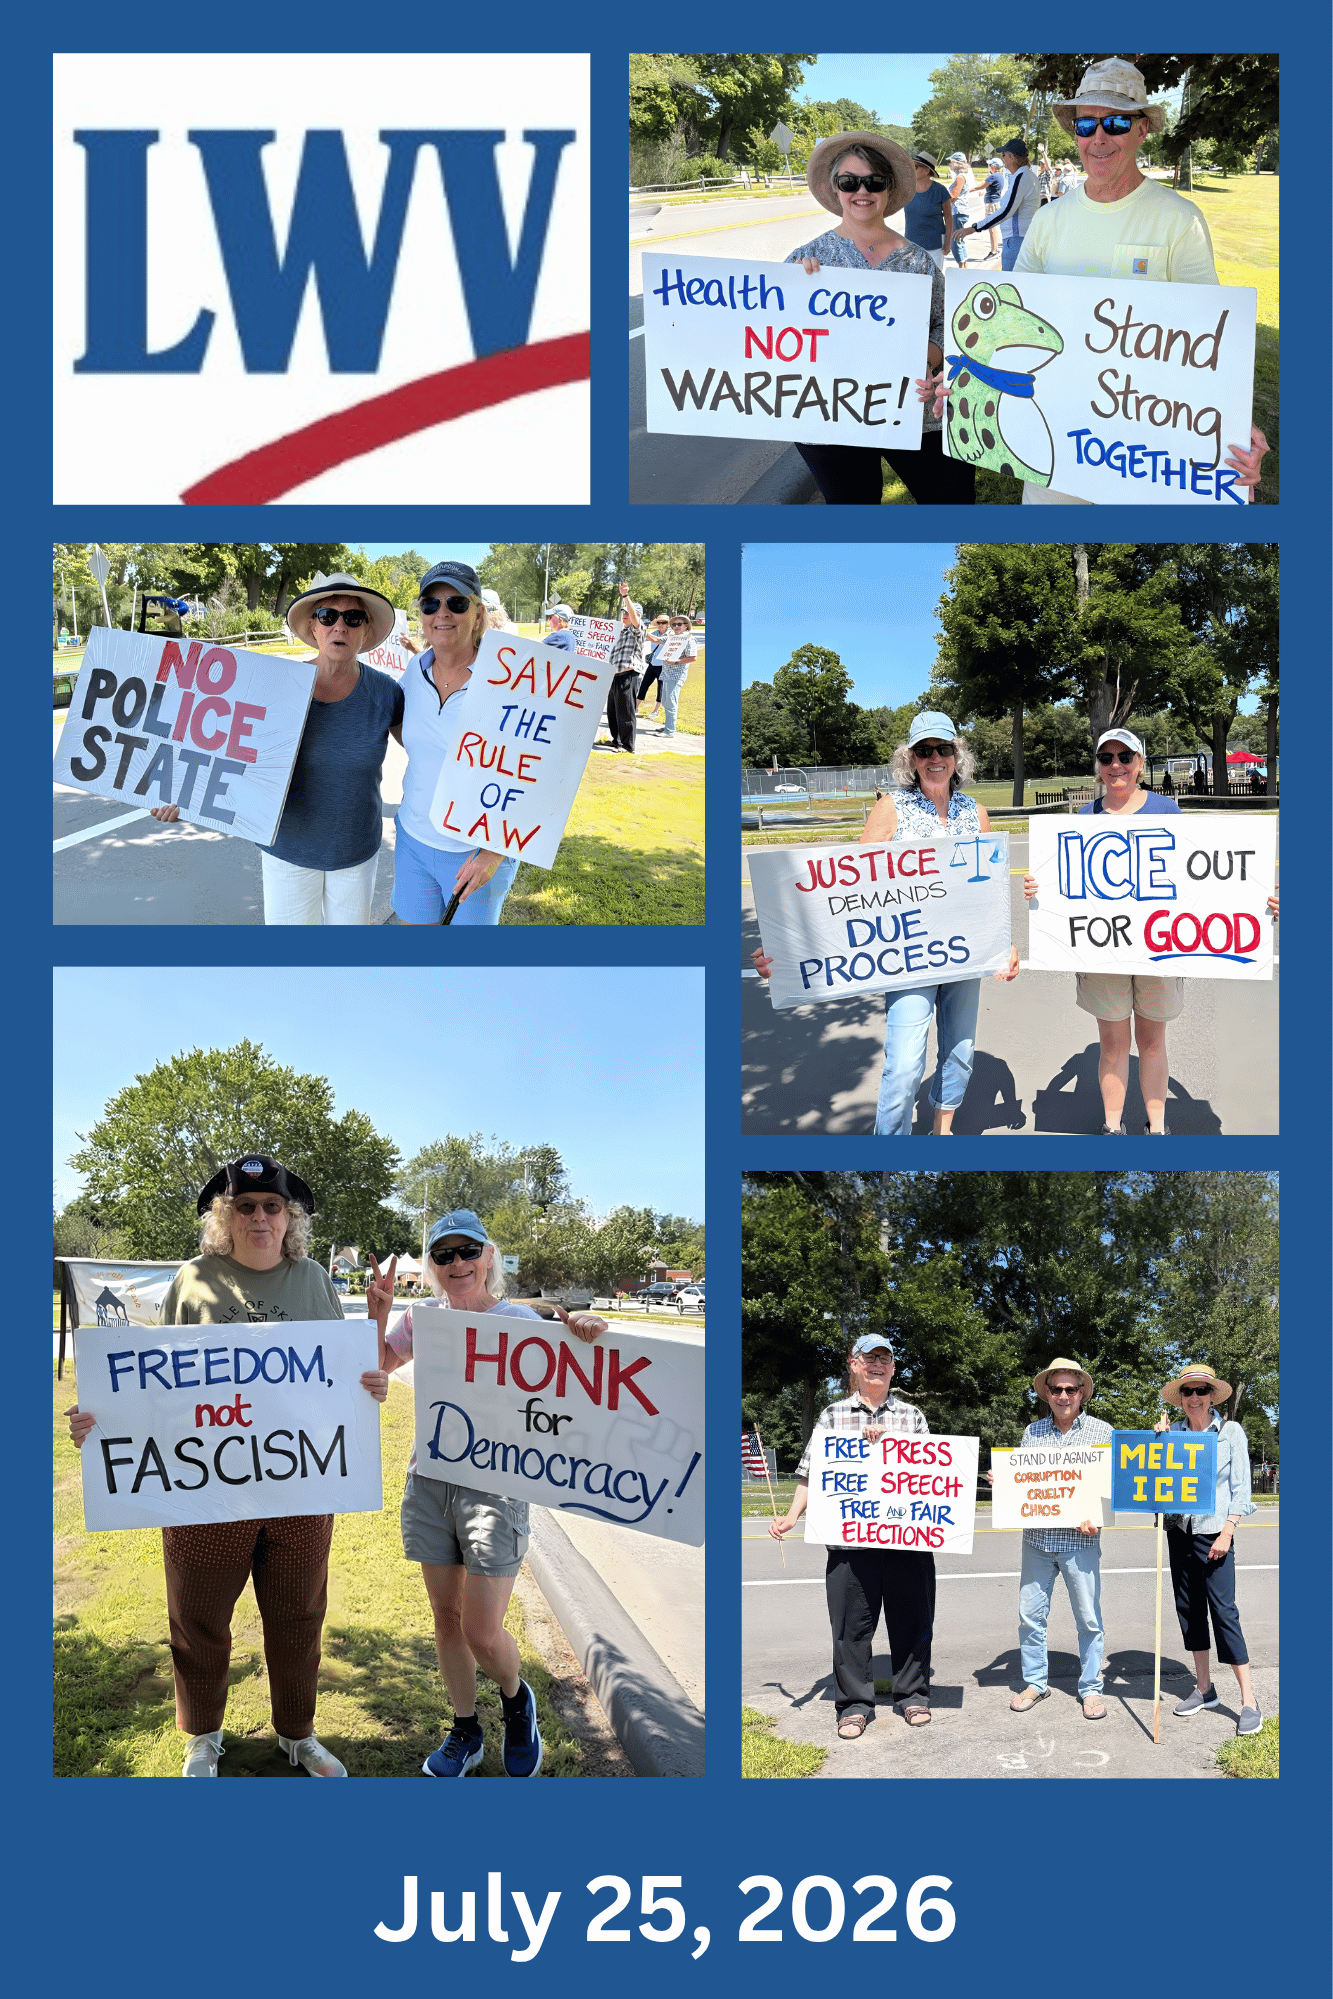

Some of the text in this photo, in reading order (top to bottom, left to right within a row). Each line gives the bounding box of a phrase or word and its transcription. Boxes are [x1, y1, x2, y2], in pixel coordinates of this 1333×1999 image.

[653, 269, 896, 327] Health care,
[744, 325, 829, 363] NOT
[1085, 297, 1229, 371] Stand
[660, 367, 909, 427] WARFARE!
[1091, 368, 1222, 471] Strong
[1067, 429, 1245, 504] TOGETHER
[587, 631, 616, 643] SPEECH
[590, 619, 614, 632] PRESS
[368, 647, 406, 672] FOR ALL
[596, 642, 610, 653] FAIR
[156, 640, 238, 695] NO
[487, 647, 598, 709] SAVE
[81, 668, 267, 763] POLICE
[499, 705, 556, 744] THE
[70, 726, 247, 825] STATE
[457, 731, 542, 783] RULE
[480, 782, 524, 812] OF
[443, 801, 541, 852] LAW
[795, 848, 940, 892] JUSTICE
[1058, 828, 1256, 901] ICE OUT
[828, 881, 947, 916] DEMANDS
[847, 909, 928, 948] DUE
[1069, 910, 1261, 954] FOR GOOD
[800, 935, 970, 990] PROCESS
[245, 1301, 264, 1309] OF
[270, 1305, 292, 1322] SK
[107, 1345, 334, 1393] FREEDOM,
[465, 1327, 660, 1416] HONK
[195, 1393, 253, 1428] not
[517, 1398, 573, 1435] for
[100, 1425, 348, 1494] FASCISM
[427, 1400, 702, 1524] Democracy!
[824, 1436, 952, 1466] FREE PRESS
[1009, 1451, 1104, 1466] STAND UP AGAINST
[1120, 1442, 1205, 1470] MELT
[822, 1470, 964, 1498] FREE SPEECH
[1014, 1469, 1082, 1483] CORRUPTION
[1027, 1486, 1075, 1500] CRUELTY
[1133, 1476, 1199, 1502] ICE
[839, 1498, 955, 1525] FREE AND FAIR
[1021, 1503, 1061, 1517] CHAOS
[842, 1521, 945, 1548] ELECTIONS
